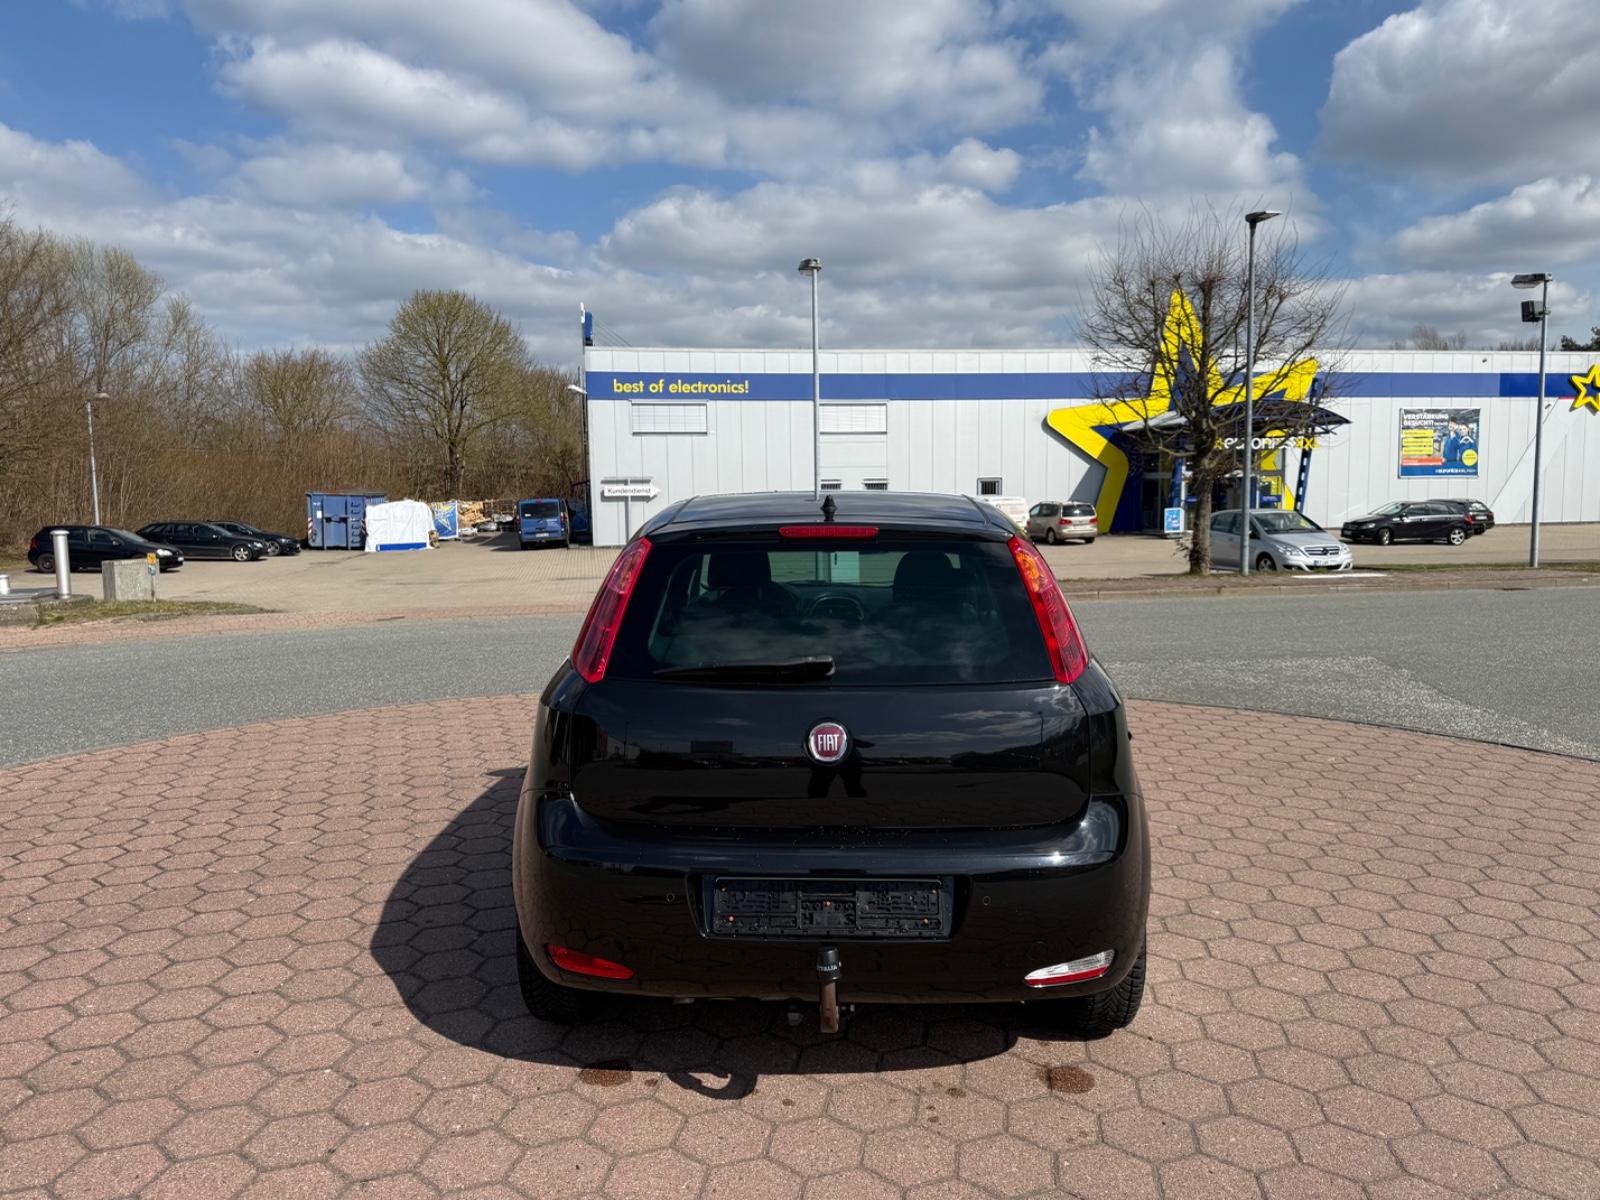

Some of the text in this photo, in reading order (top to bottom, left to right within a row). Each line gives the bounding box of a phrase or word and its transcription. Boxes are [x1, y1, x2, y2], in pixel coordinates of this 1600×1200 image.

[613, 378, 749, 394] best of electronics!
[607, 487, 651, 495] Kundendienst
[817, 734, 840, 751] FIAT
